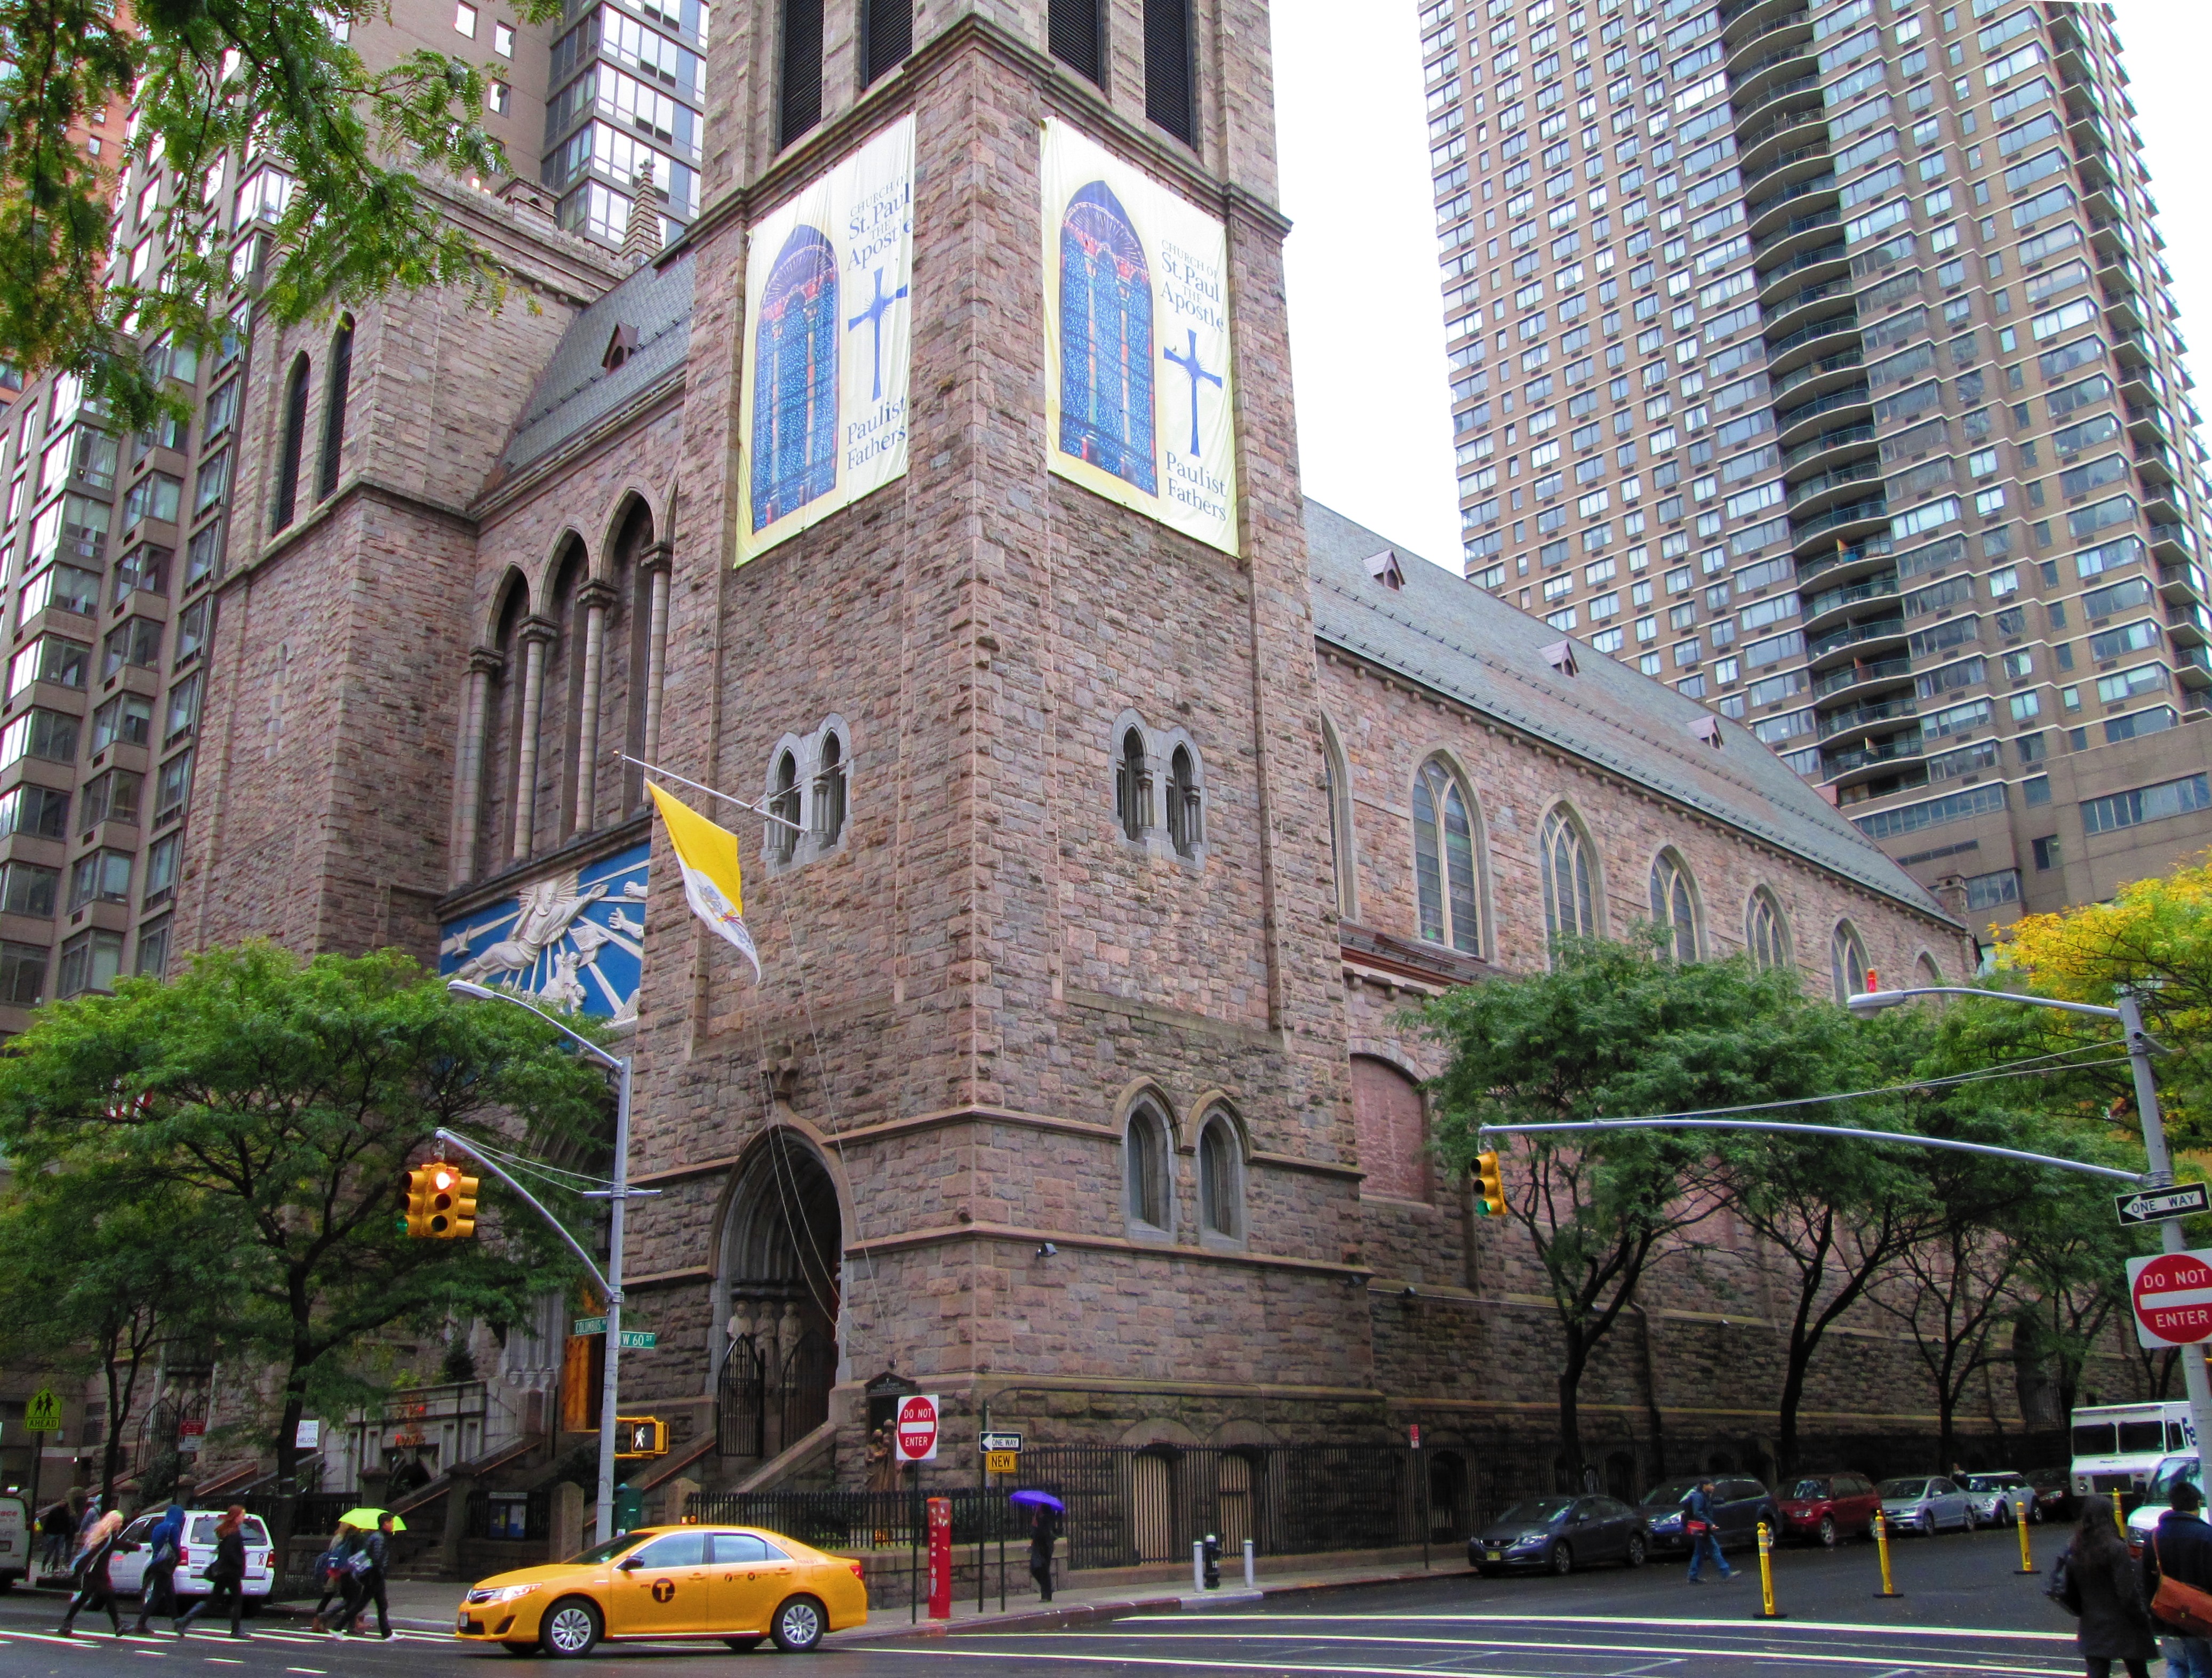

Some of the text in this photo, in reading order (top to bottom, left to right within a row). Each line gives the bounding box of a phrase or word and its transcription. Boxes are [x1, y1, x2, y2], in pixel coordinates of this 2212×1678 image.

[849, 182, 910, 241] St. Paul
[850, 182, 893, 217] CHURCH
[871, 220, 890, 239] THE
[847, 218, 914, 271] Apostle
[1162, 239, 1204, 271] CHURCH
[1162, 251, 1220, 303] St. Paul
[1160, 281, 1224, 333] Apostle
[1182, 285, 1202, 304] THE
[847, 396, 906, 446] Paulist
[847, 425, 905, 472] Fathers
[1165, 450, 1226, 497] Paulist
[1167, 476, 1226, 521] Fathers
[2131, 1193, 2194, 1213] ONE WAY
[2143, 1268, 2206, 1289] DO NOT
[576, 1320, 601, 1333] COLUMBUS
[2155, 1310, 2209, 1328] ENTER
[622, 1334, 629, 1345] W
[633, 1335, 644, 1346] 60
[904, 1408, 932, 1419] DO NOT
[905, 1436, 928, 1447] ENTER
[992, 1455, 1010, 1467] NEW
